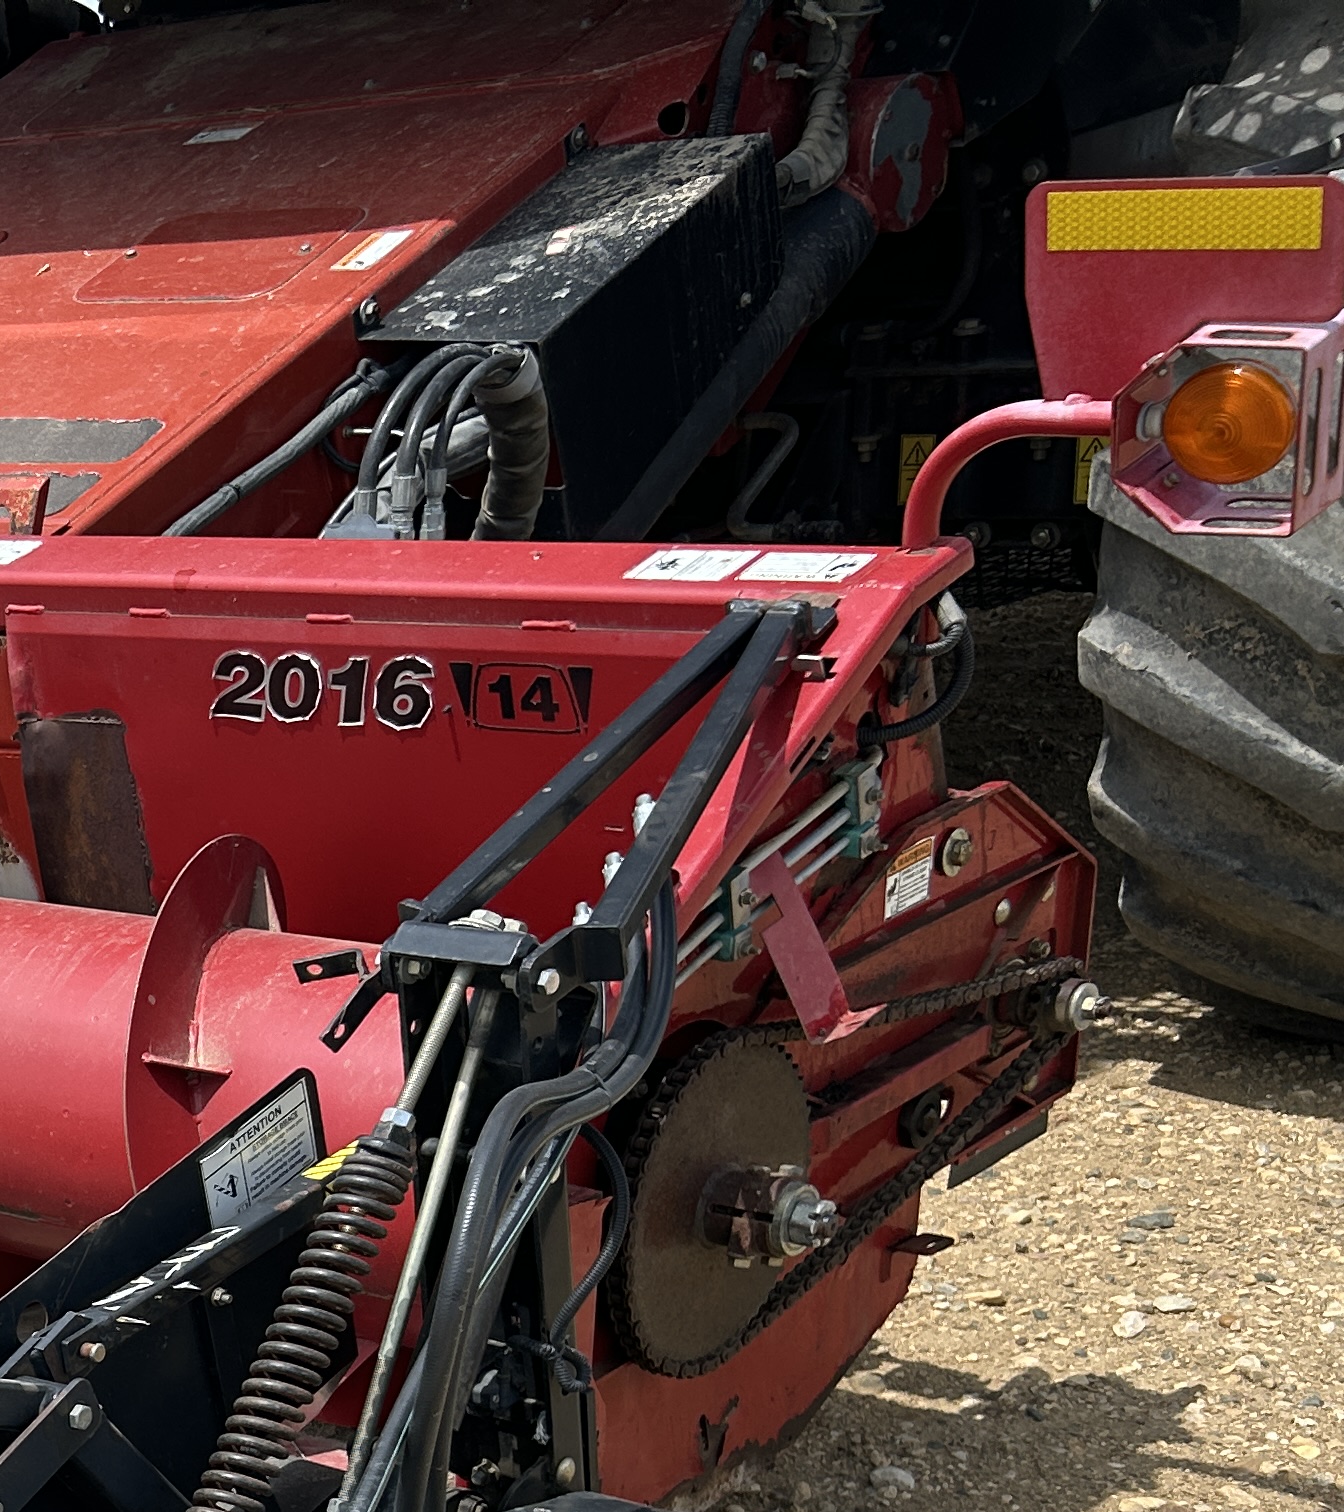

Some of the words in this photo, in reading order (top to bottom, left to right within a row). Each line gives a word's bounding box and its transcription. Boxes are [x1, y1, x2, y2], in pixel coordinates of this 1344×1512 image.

[209, 650, 435, 732] 2016
[488, 673, 560, 723] 14
[230, 1104, 282, 1155] ATTENTION
